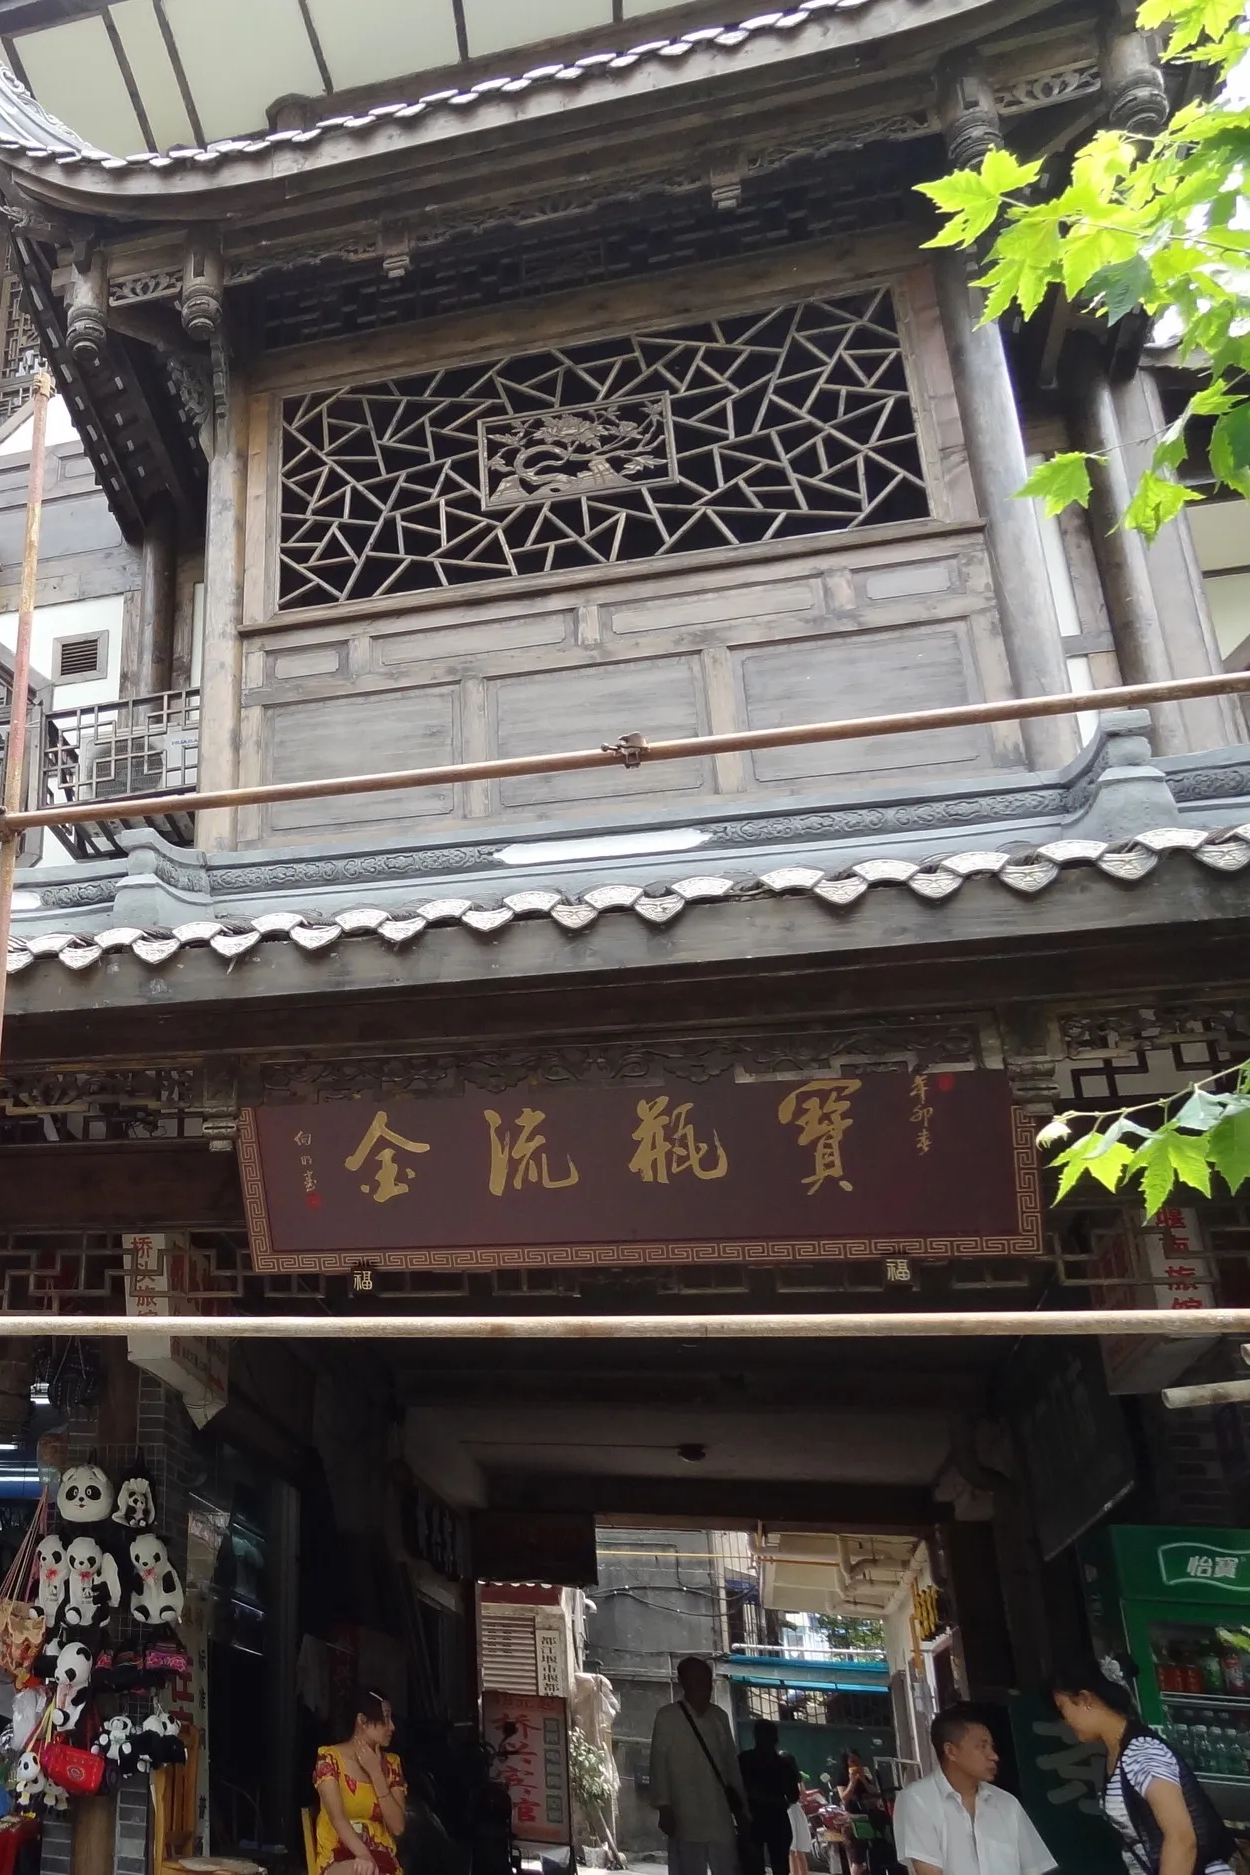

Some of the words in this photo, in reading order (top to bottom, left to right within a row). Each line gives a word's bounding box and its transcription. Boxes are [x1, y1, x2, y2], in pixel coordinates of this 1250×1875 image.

[130, 1236, 158, 1317] 桥头旅
[353, 1270, 373, 1291] 福
[885, 1258, 911, 1281] 福
